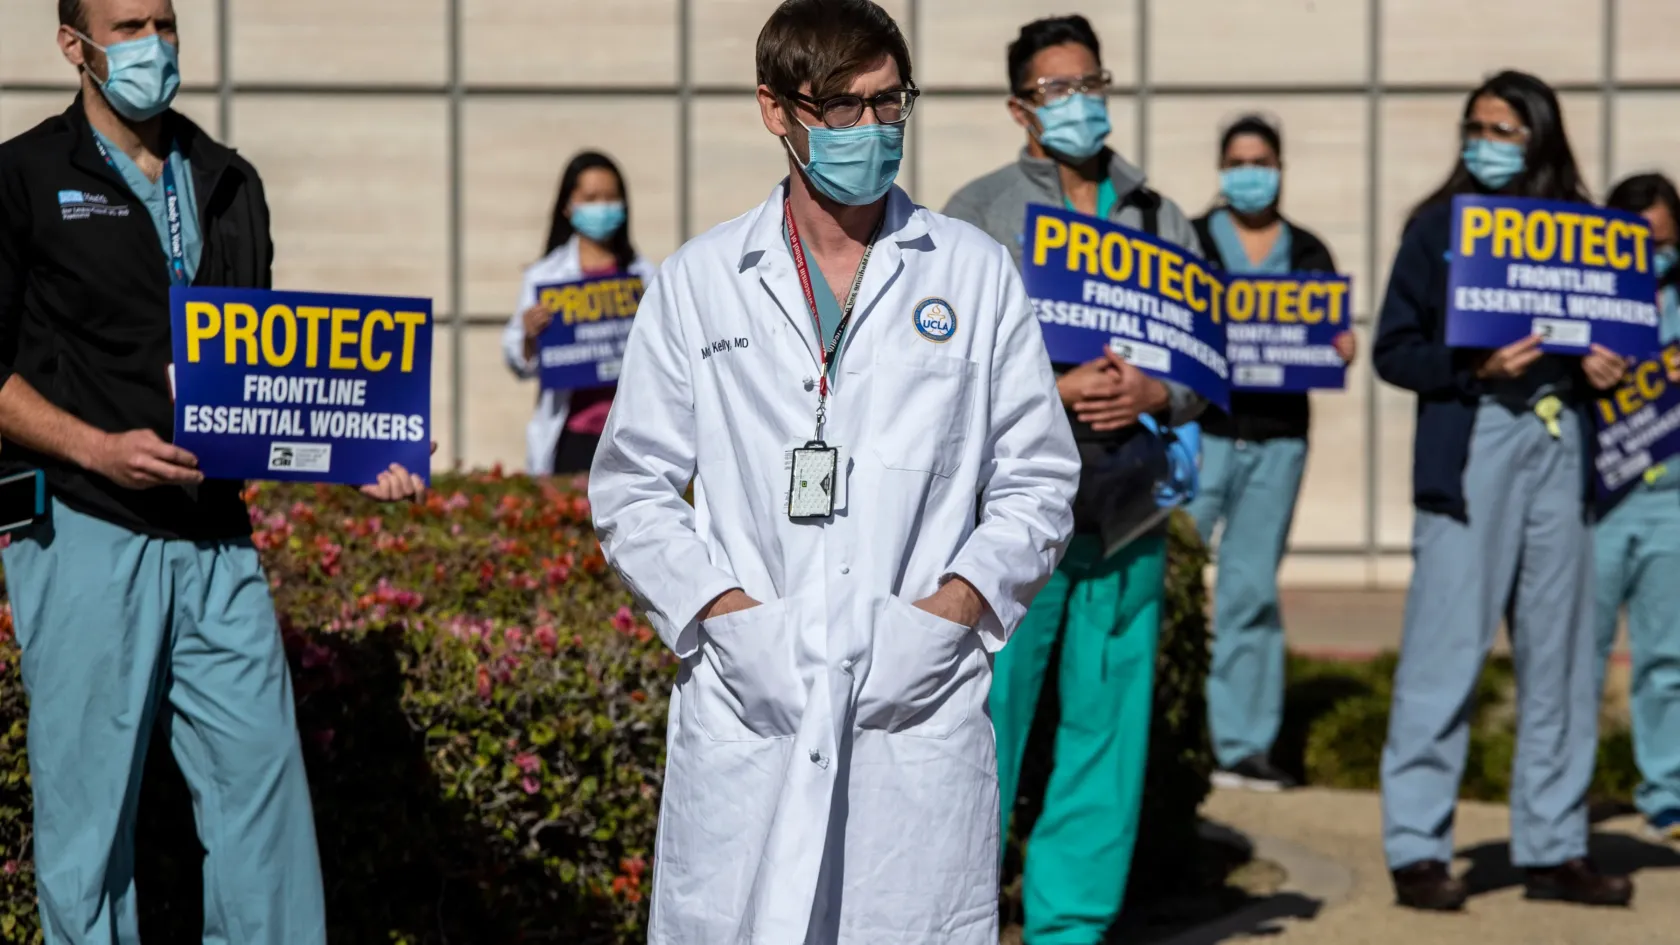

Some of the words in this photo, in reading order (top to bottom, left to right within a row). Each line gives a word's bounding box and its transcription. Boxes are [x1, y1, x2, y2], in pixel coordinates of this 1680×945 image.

[793, 243, 804, 268] School
[1460, 206, 1650, 273] PROTECT
[800, 268, 813, 305] Wisconsin
[1033, 215, 1224, 324] PROTECT
[1507, 263, 1617, 295] FRONTLINE
[541, 278, 642, 325] PROTEC
[1083, 279, 1194, 332] FRONTLINE
[1226, 280, 1348, 325] OTECT
[1454, 287, 1565, 317] ESSENTIAL
[1566, 294, 1659, 327] WORKERS
[185, 301, 426, 372] PROTECT
[712, 339, 732, 353] Kelly,
[734, 337, 749, 348] MD
[923, 320, 949, 331] UCLA
[1146, 319, 1229, 380] WORKERS
[243, 374, 367, 406] FRONTLINE
[184, 404, 305, 437] ESSENTIAL
[310, 410, 424, 442] WORKERS
